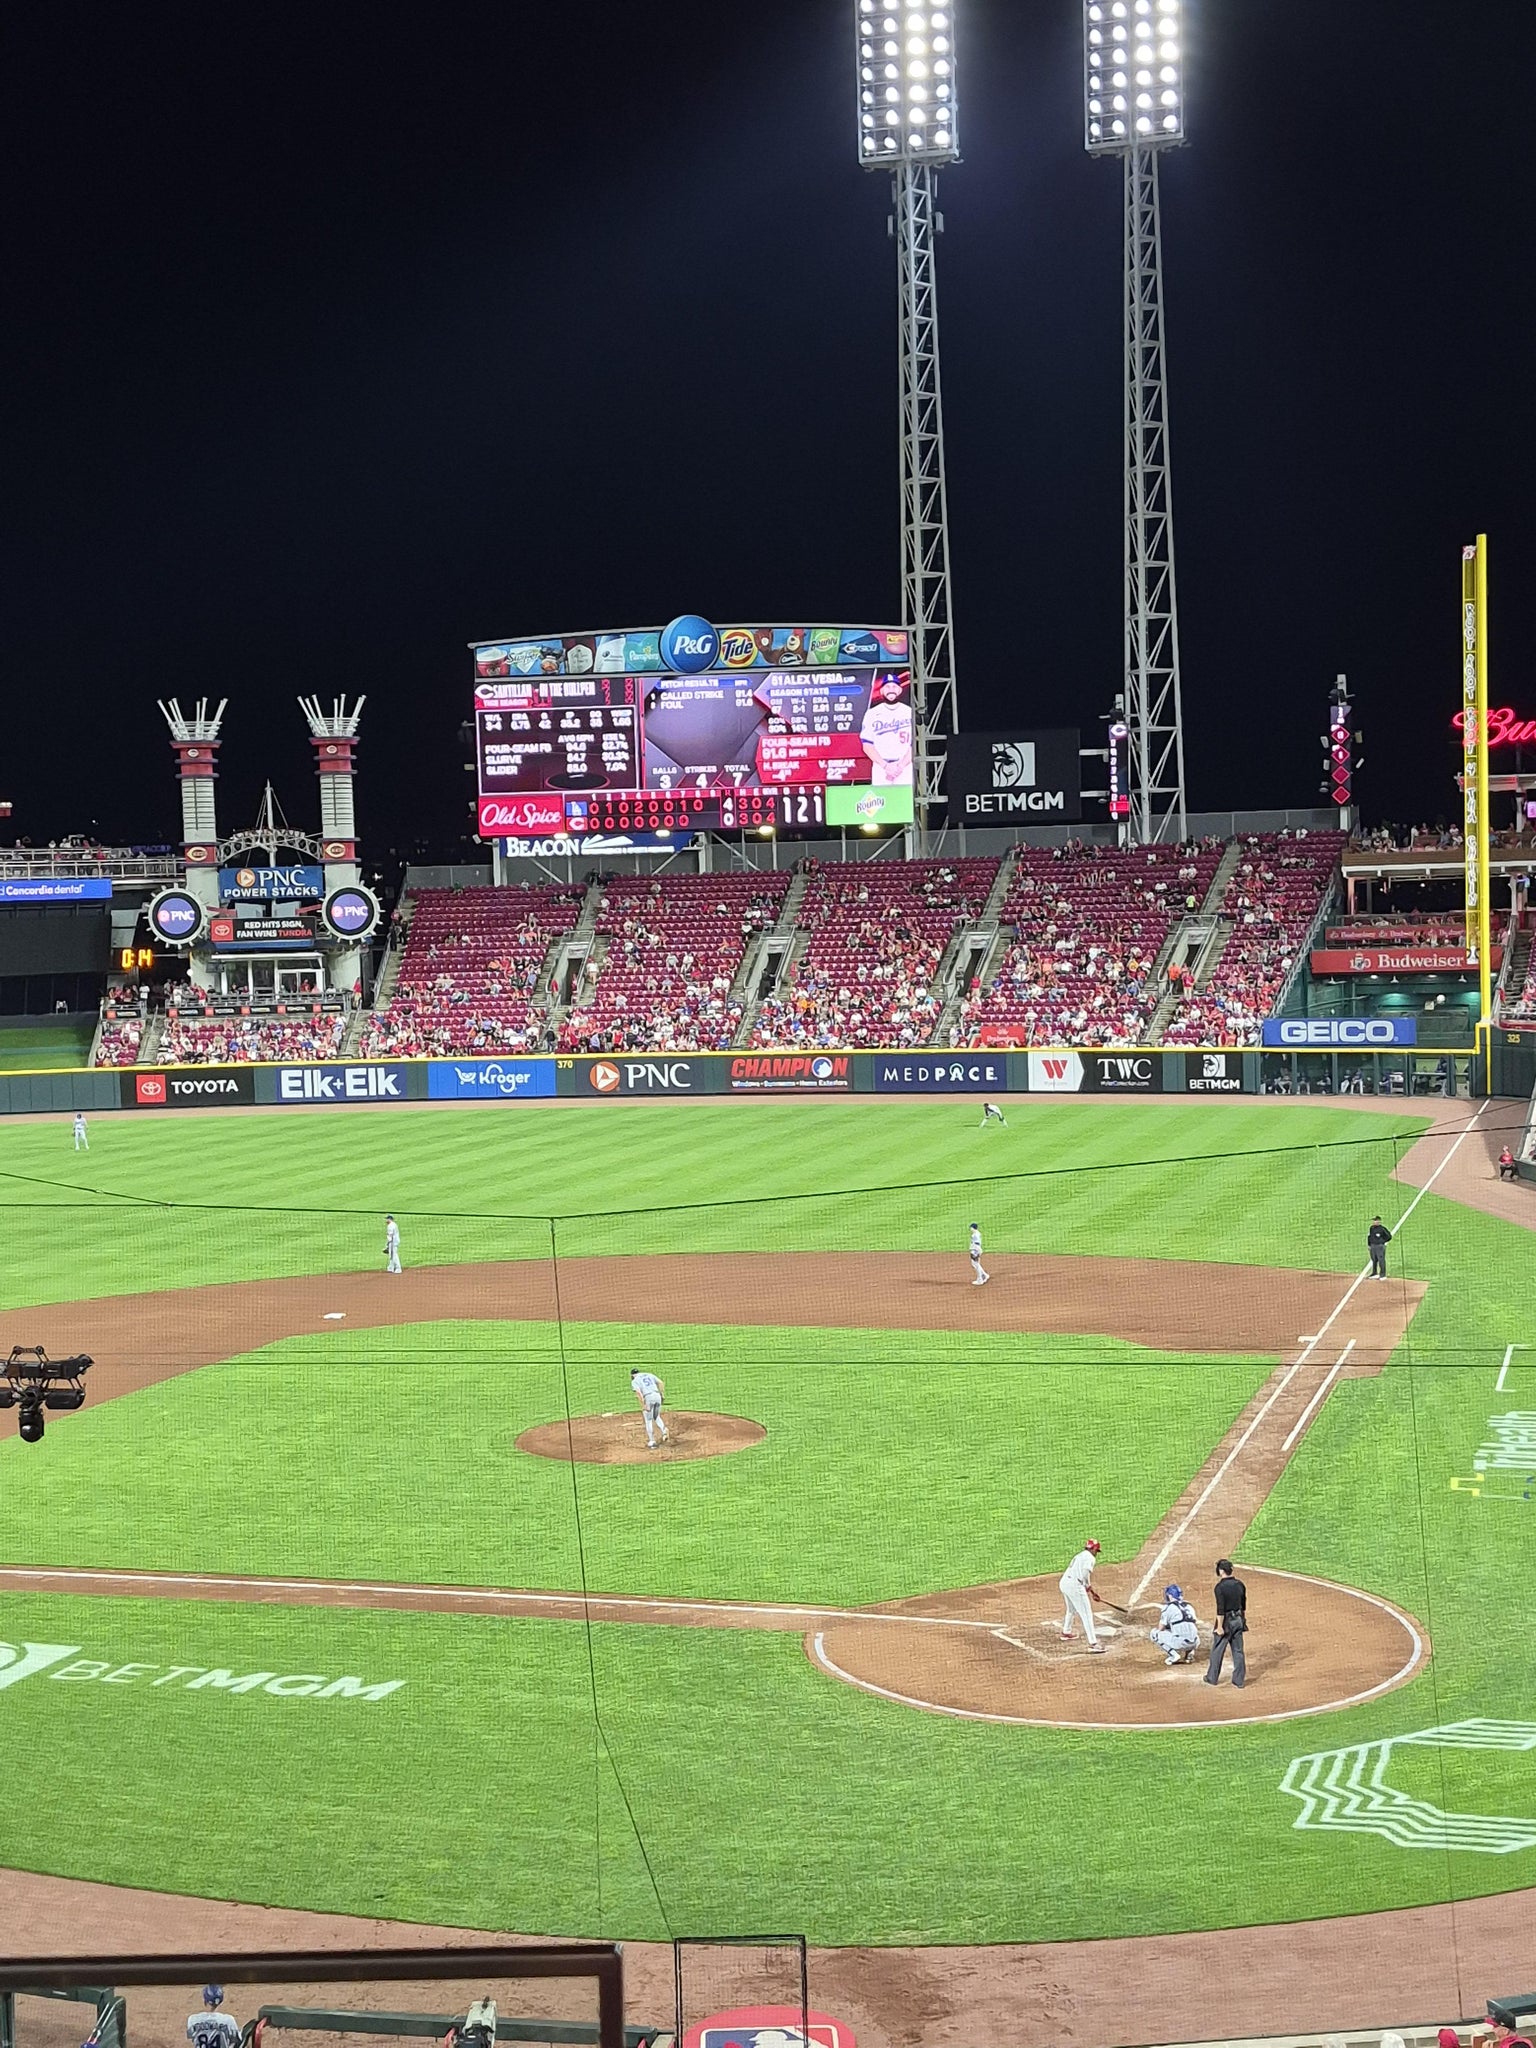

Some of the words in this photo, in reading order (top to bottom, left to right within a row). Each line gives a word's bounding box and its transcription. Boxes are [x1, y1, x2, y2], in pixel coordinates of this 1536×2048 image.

[1465, 603, 1476, 651] ROOT
[673, 634, 713, 655] P&G
[722, 638, 753, 661] Tide
[811, 636, 838, 651] Bounty
[784, 674, 811, 685] ALEX
[811, 673, 844, 684] VESIA
[1465, 653, 1476, 700] ROOT
[661, 691, 693, 701] CALLED
[694, 690, 724, 699] STRIKE
[770, 689, 802, 697] SEASON
[661, 700, 684, 709] FOUL
[899, 732, 910, 744] 51
[1466, 707, 1476, 755] ROOT
[485, 743, 539, 754] FOUR-SEAM
[762, 737, 817, 748] FOUR-SEAM
[818, 736, 831, 746] FB
[788, 748, 808, 758] MPH
[652, 767, 677, 775] BALLS
[724, 764, 751, 773] TOTAL
[1466, 762, 1476, 776] 4
[659, 774, 672, 789] 3
[695, 773, 708, 789] 4
[732, 772, 743, 788] 7
[589, 802, 599, 815] 0
[606, 802, 613, 814] 1
[618, 801, 629, 814] 0
[634, 801, 644, 813] 2
[649, 800, 659, 813] 0
[663, 800, 674, 813] 0
[680, 800, 687, 812] 1
[693, 799, 704, 811] 0
[723, 797, 733, 811] 4
[738, 797, 748, 810] 3
[751, 797, 762, 809] 0
[765, 797, 775, 809] 4
[783, 796, 792, 824] 1
[797, 795, 809, 823] 2
[813, 795, 823, 823] 1
[856, 799, 885, 812] Bounty
[965, 791, 1065, 813] BETMGM
[481, 803, 515, 827] Old
[515, 803, 561, 833] Spice
[589, 817, 600, 830] 0
[604, 817, 615, 830] 0
[619, 816, 630, 829] 0
[634, 816, 645, 829] 0
[649, 815, 660, 828] 0
[663, 815, 674, 827] 0
[678, 814, 690, 827] 0
[723, 812, 734, 826] 0
[739, 812, 749, 825] 3
[752, 812, 762, 824] 0
[766, 812, 776, 824] 4
[506, 837, 580, 858] BEACON
[258, 869, 306, 887] PNC
[5, 885, 54, 896] Concordia
[54, 884, 83, 895] dental
[224, 888, 268, 898] POWER
[271, 886, 319, 897] STACKS
[171, 910, 195, 921] PNC
[344, 906, 369, 917] PNC
[244, 921, 261, 930] RED
[262, 920, 280, 929] HITS
[281, 920, 304, 929] SIGN,
[236, 930, 254, 939] FAN
[254, 930, 278, 938] WINS
[278, 929, 313, 937] TUNDRA
[121, 949, 153, 969] 0:14
[1378, 954, 1464, 969] Budweiser
[1280, 1020, 1394, 1043] GEICO
[557, 1059, 574, 1069] 370
[731, 1056, 849, 1079] CHAMPION
[1096, 1058, 1152, 1080] TWC
[280, 1067, 400, 1099] Elk+Elk
[479, 1063, 531, 1093] Kroger
[624, 1062, 692, 1089] PNC
[171, 1078, 239, 1095] TOYOTA
[1189, 1079, 1240, 1090] BETMGM
[49, 1659, 408, 1701] BETMGM
